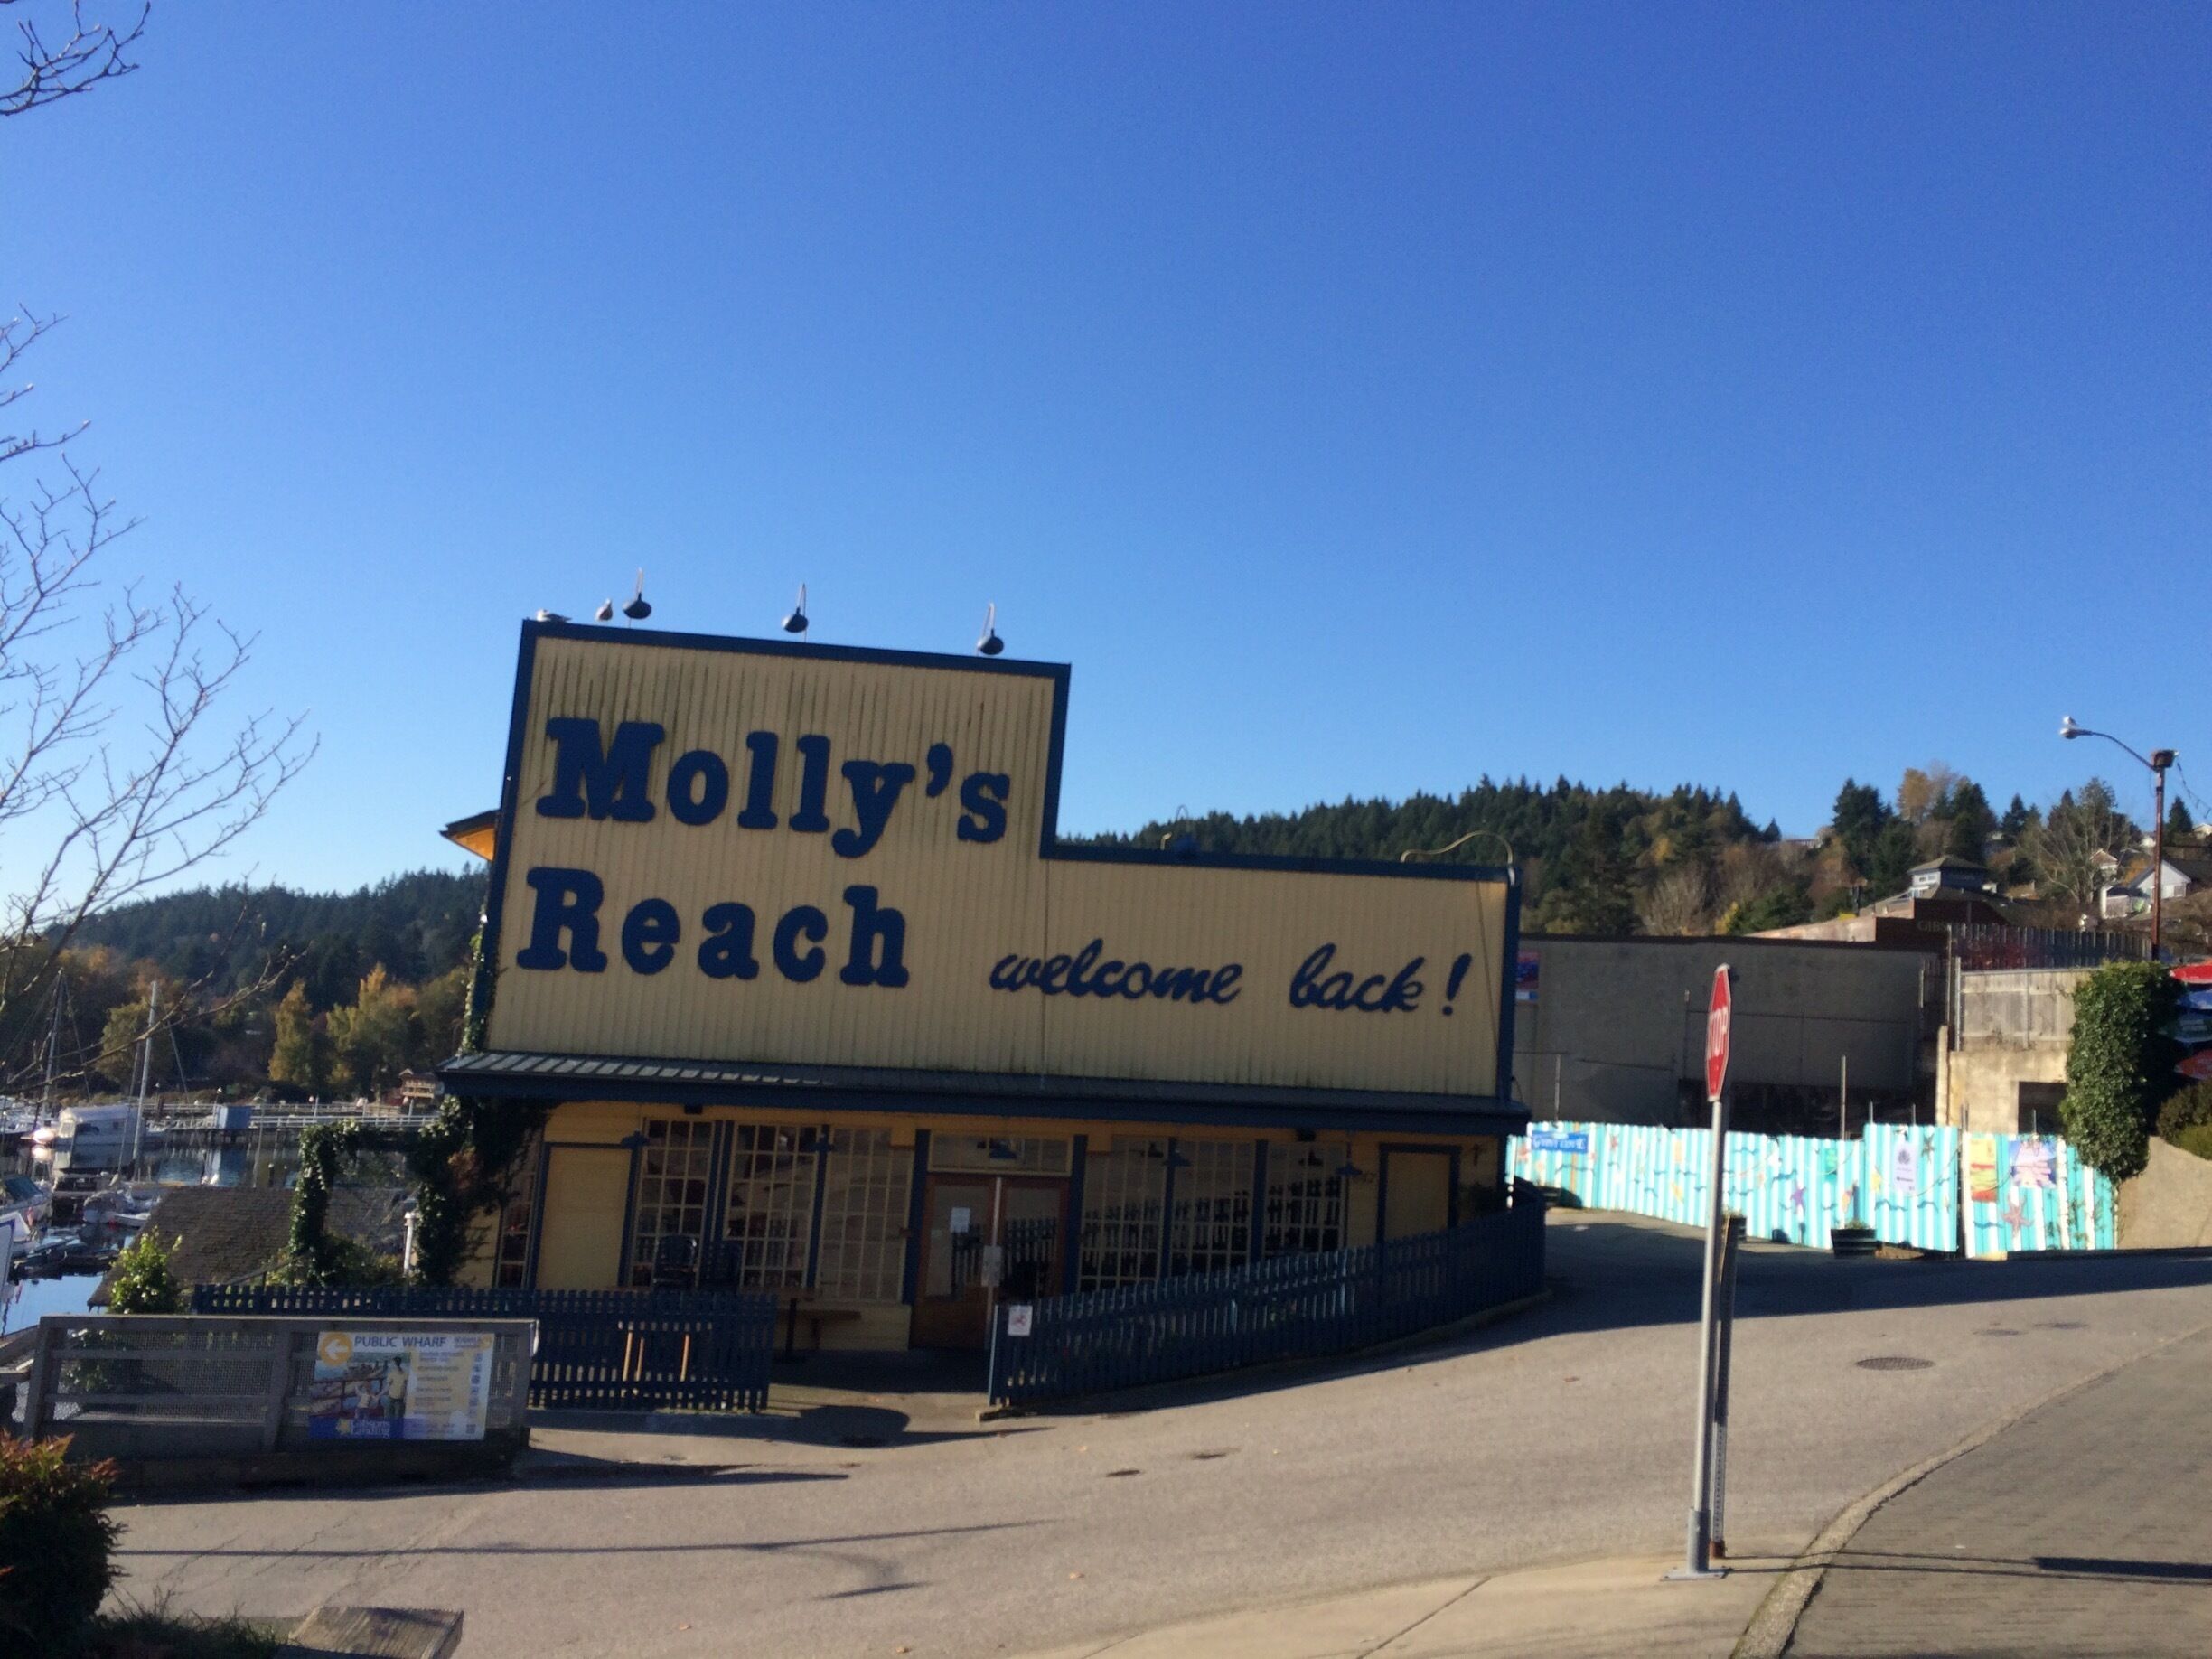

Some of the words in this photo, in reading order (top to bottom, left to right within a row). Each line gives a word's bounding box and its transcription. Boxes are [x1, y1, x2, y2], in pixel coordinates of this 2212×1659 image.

[536, 717, 1010, 858] Molly's
[517, 867, 909, 988] Reach
[989, 939, 1243, 1004] welcome
[354, 1336, 397, 1347] PUBLIC
[402, 1336, 446, 1347] WHARF
